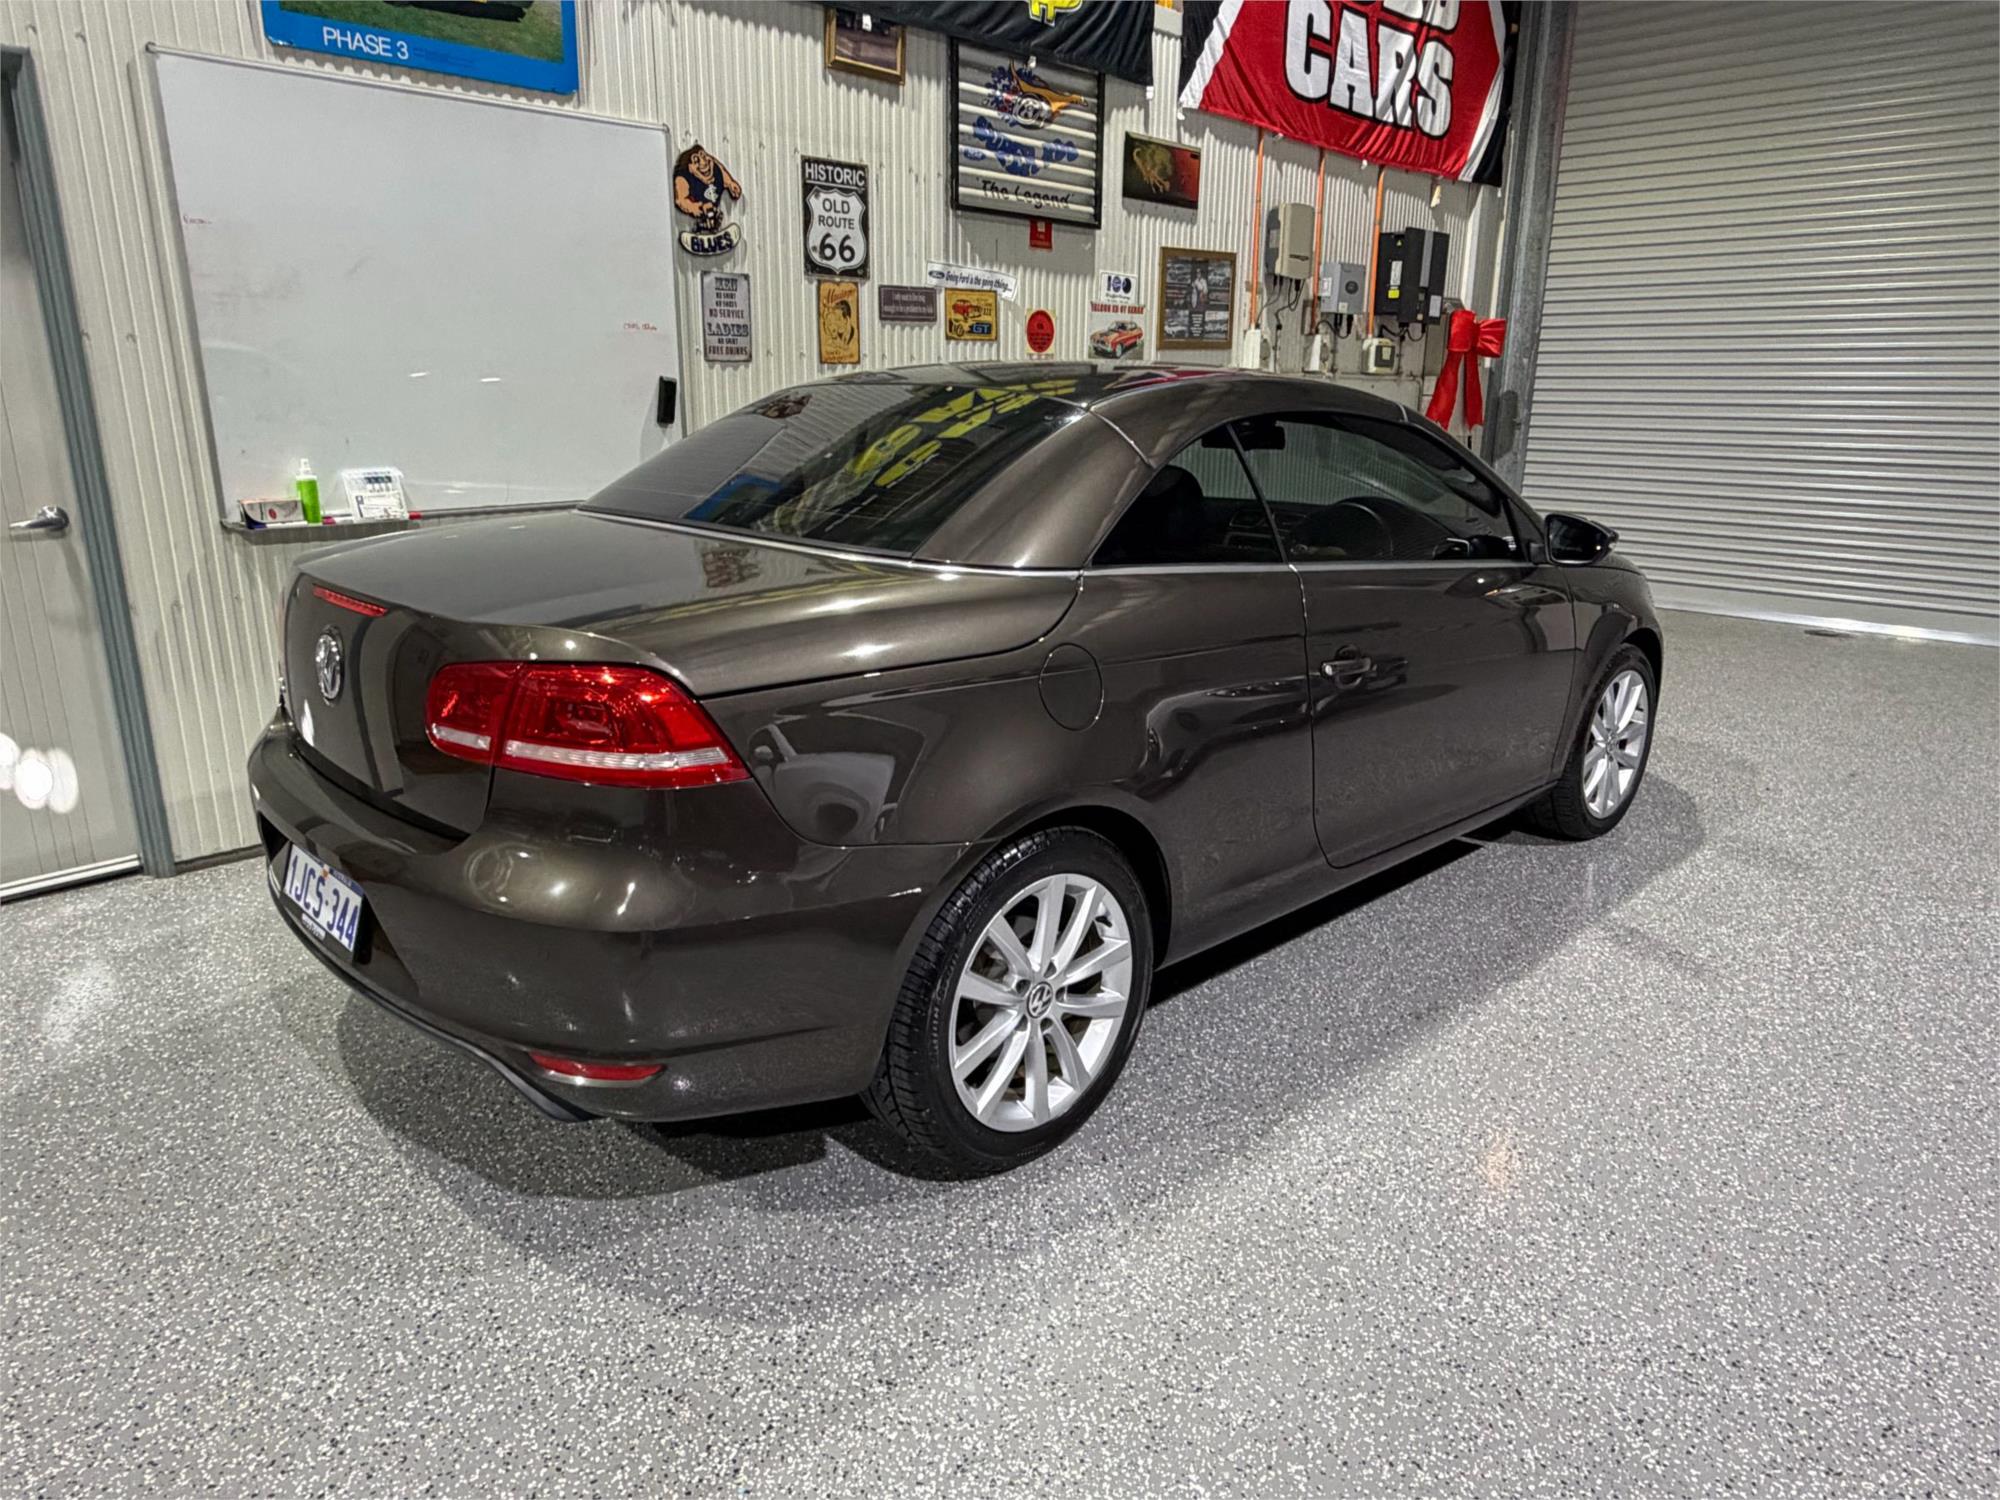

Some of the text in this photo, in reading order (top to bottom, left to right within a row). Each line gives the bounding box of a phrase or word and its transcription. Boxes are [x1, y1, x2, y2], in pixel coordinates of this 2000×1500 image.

[323, 25, 409, 60] PHASE 3
[1285, 0, 1453, 138] CARS
[805, 161, 865, 187] HISTORIC
[822, 198, 850, 214] OLD
[818, 214, 855, 230] ROUTE
[691, 231, 733, 253] BLUES
[819, 232, 855, 263] 66
[973, 324, 990, 333] GT
